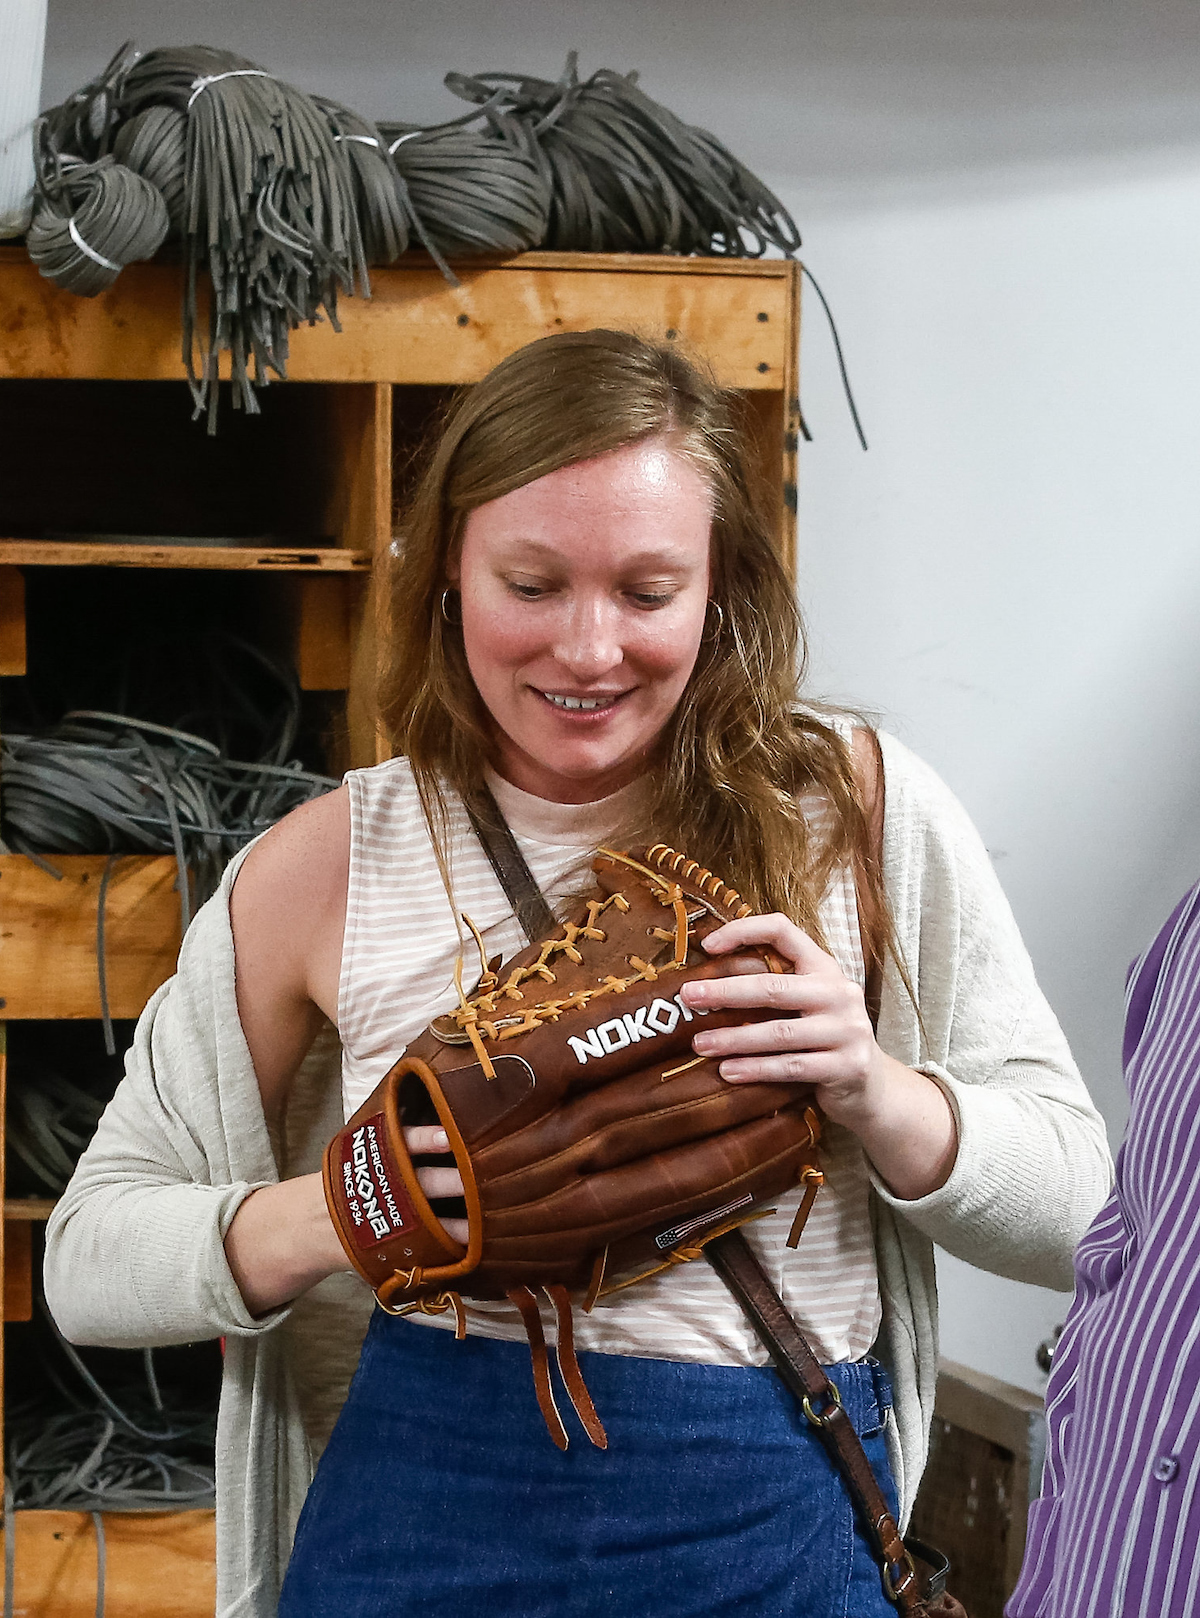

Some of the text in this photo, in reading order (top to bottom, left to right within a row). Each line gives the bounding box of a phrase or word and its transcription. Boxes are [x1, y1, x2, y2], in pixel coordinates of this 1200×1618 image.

[343, 1162, 364, 1226] SINCE 1934
[352, 1127, 390, 1239] NOKONA
[367, 1126, 402, 1227] AMERICAN MADE
